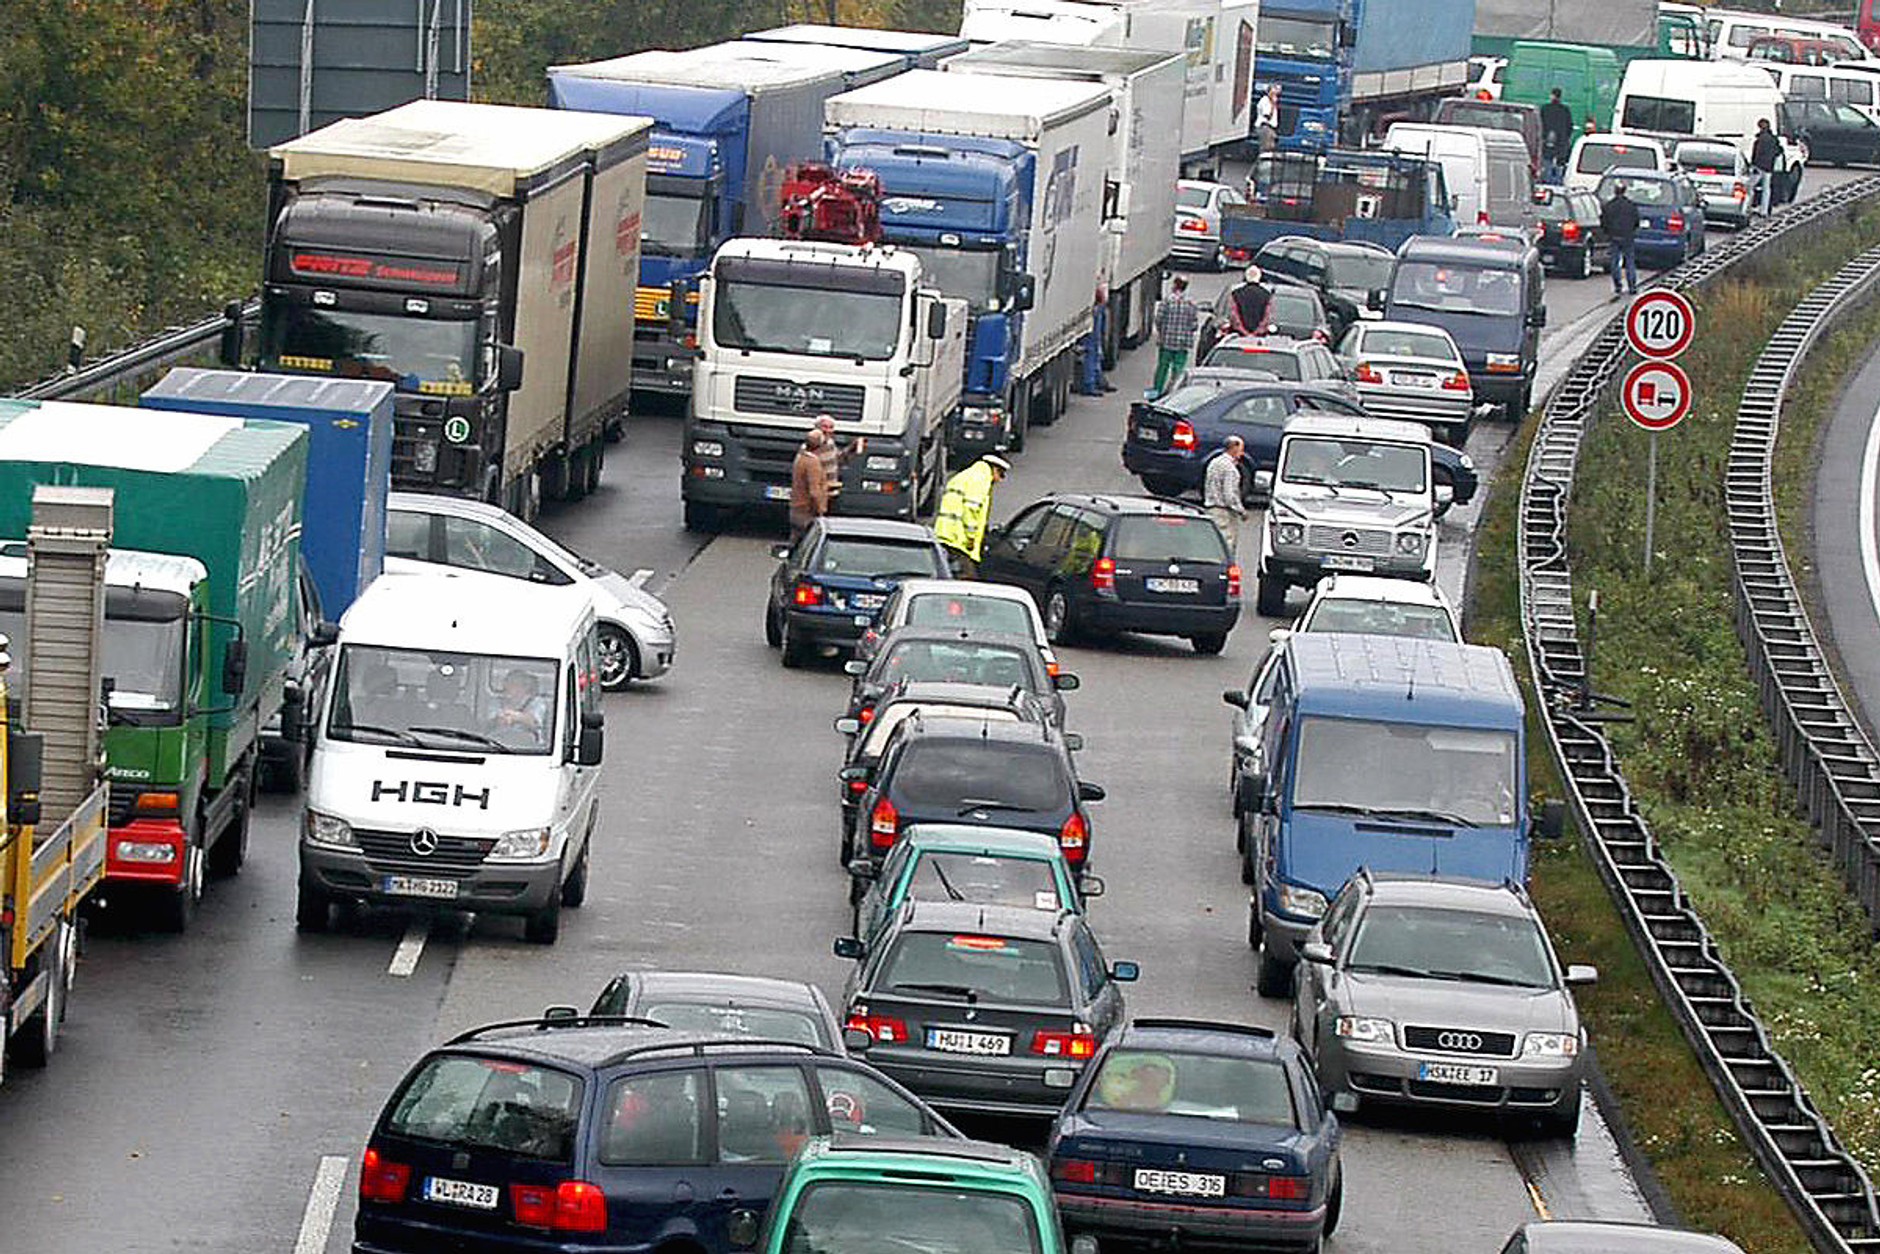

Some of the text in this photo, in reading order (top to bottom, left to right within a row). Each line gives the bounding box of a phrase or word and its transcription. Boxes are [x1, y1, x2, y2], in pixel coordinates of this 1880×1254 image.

[1640, 310, 1679, 340] 120
[775, 386, 824, 400] MAN
[451, 421, 461, 434] L
[371, 780, 490, 810] HGH
[978, 1037, 1005, 1051] 469
[1198, 1176, 1222, 1193] 316
[476, 1187, 493, 1204] 28
